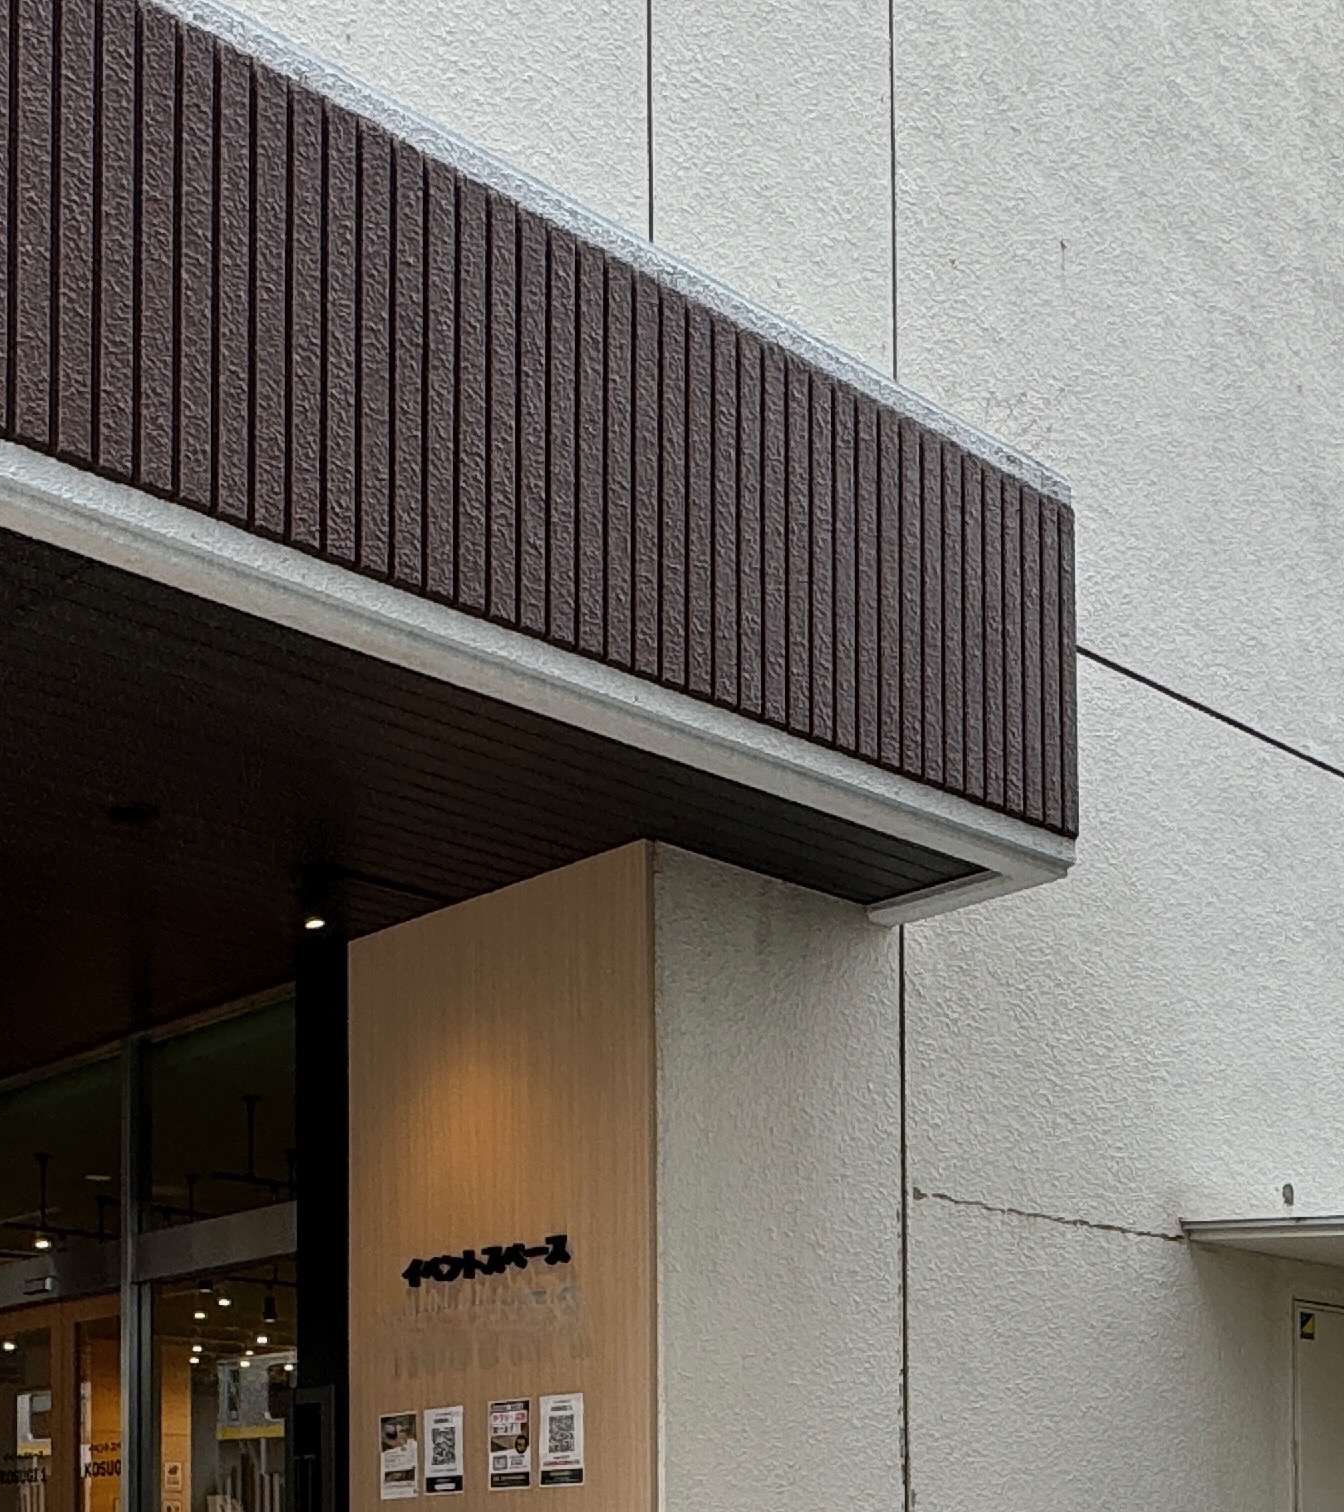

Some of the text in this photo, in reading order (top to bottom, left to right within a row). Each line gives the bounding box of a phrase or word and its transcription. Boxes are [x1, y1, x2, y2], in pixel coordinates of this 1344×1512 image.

[401, 1234, 572, 1288] イベントスペース
